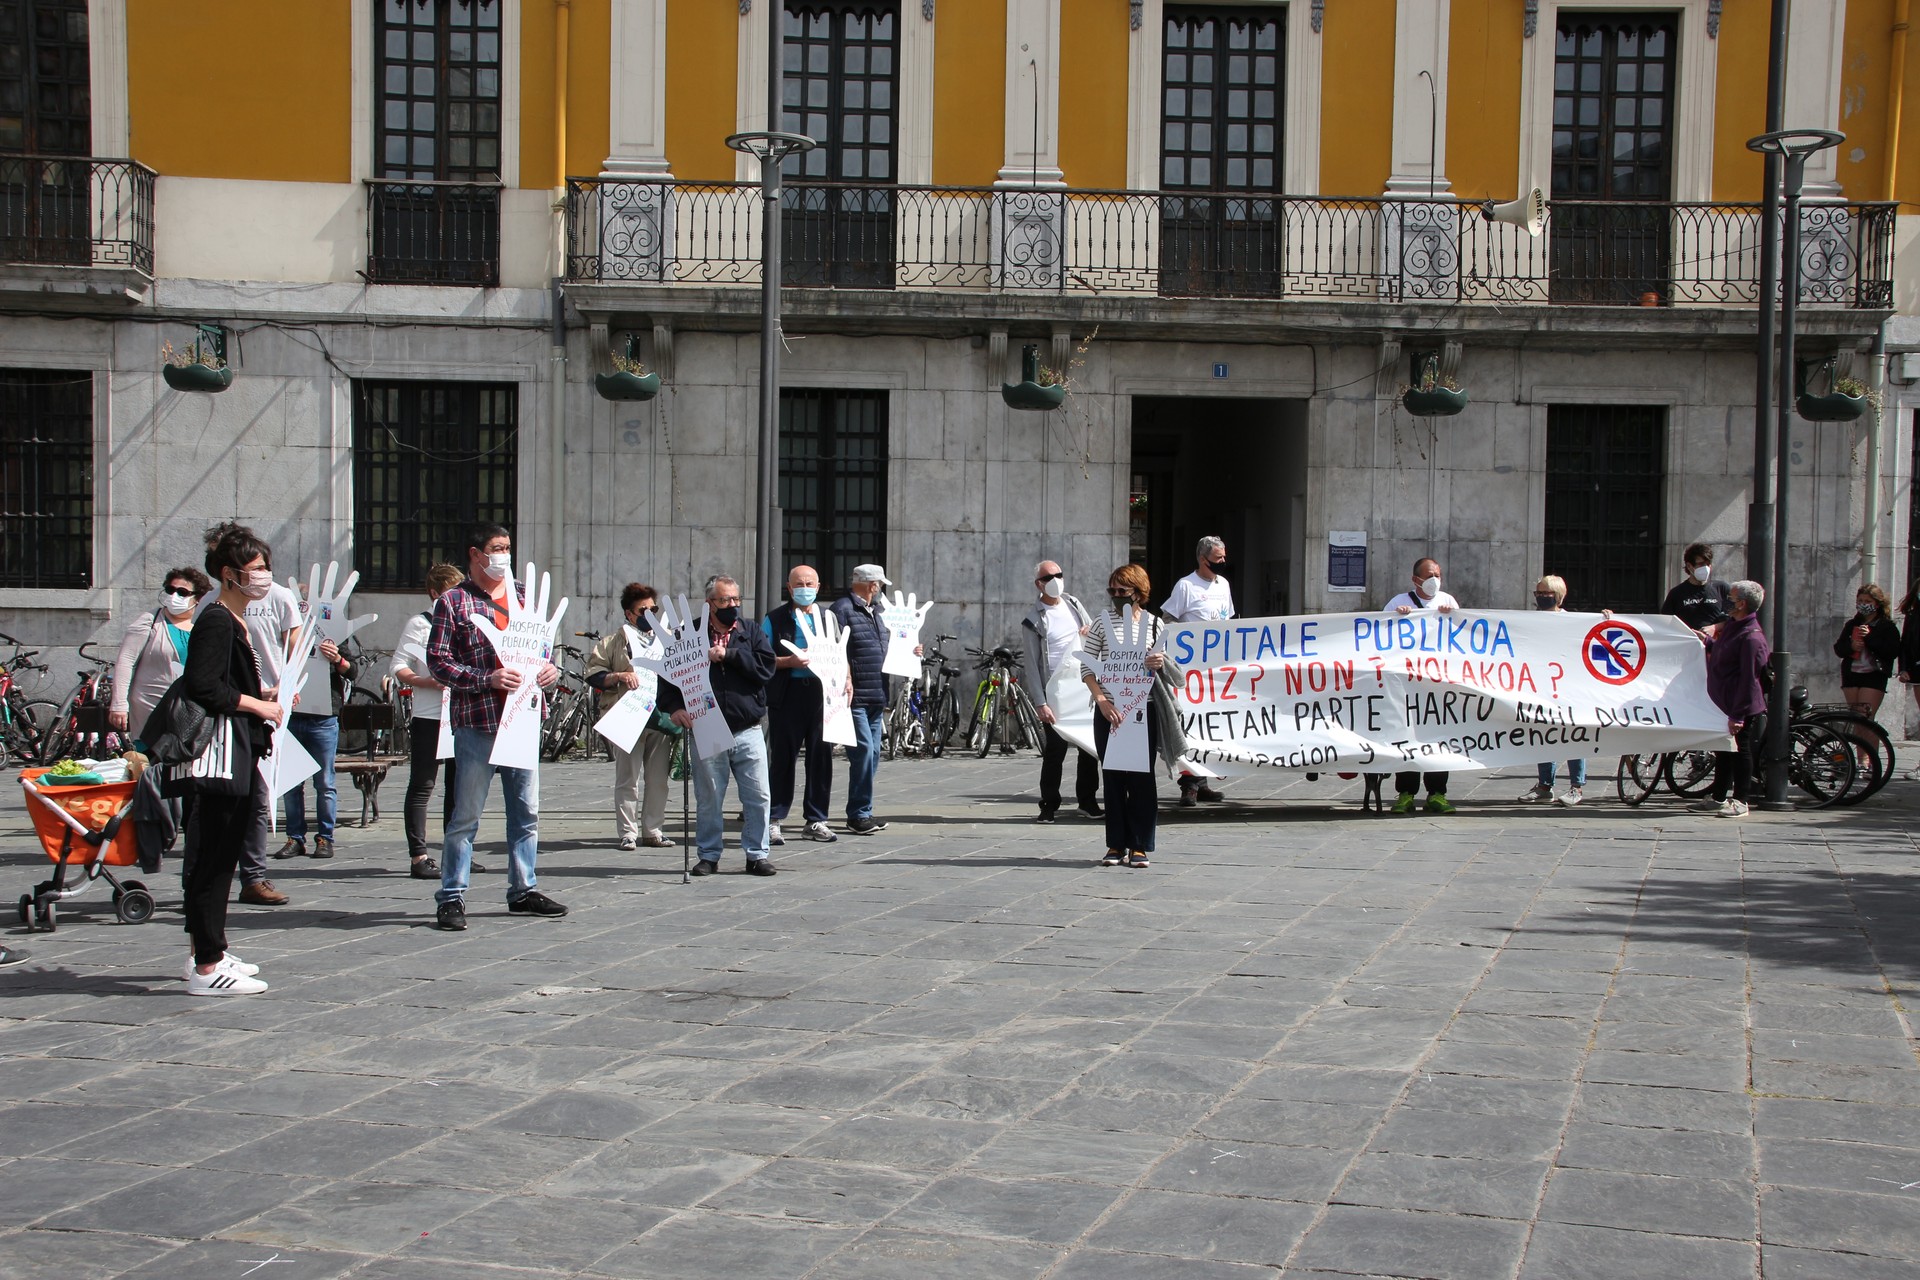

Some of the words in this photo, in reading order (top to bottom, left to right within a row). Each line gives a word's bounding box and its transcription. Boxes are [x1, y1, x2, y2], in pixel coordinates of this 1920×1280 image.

[1218, 365, 1223, 377] 1
[509, 620, 551, 638] HOSPITAL
[501, 636, 538, 650] PUBLIKO
[664, 636, 703, 659] OSPITALE
[1165, 621, 1319, 665] SPITALE
[1353, 616, 1515, 658] PUBLIKOA
[500, 650, 548, 669] Participacio
[663, 649, 704, 672] PUBLIKOA
[1110, 650, 1149, 661] OSPITALE
[670, 660, 711, 680] ERABAKIETAN
[1103, 662, 1146, 673] PUBLIKOA
[681, 673, 702, 688] PARTE
[1100, 672, 1121, 685] Parte
[1122, 673, 1153, 685] hartzea
[683, 684, 703, 697] HARTU
[1119, 686, 1134, 697] eta
[687, 695, 704, 708] NAHI
[689, 706, 707, 721] DUGU
[1294, 694, 1385, 732] PARTE
[1405, 690, 1496, 727] HARTU
[1515, 701, 1576, 727] NAHI
[1595, 705, 1674, 728] DUGU
[1358, 742, 1375, 765] y
[1391, 726, 1600, 763] Transparencia!
